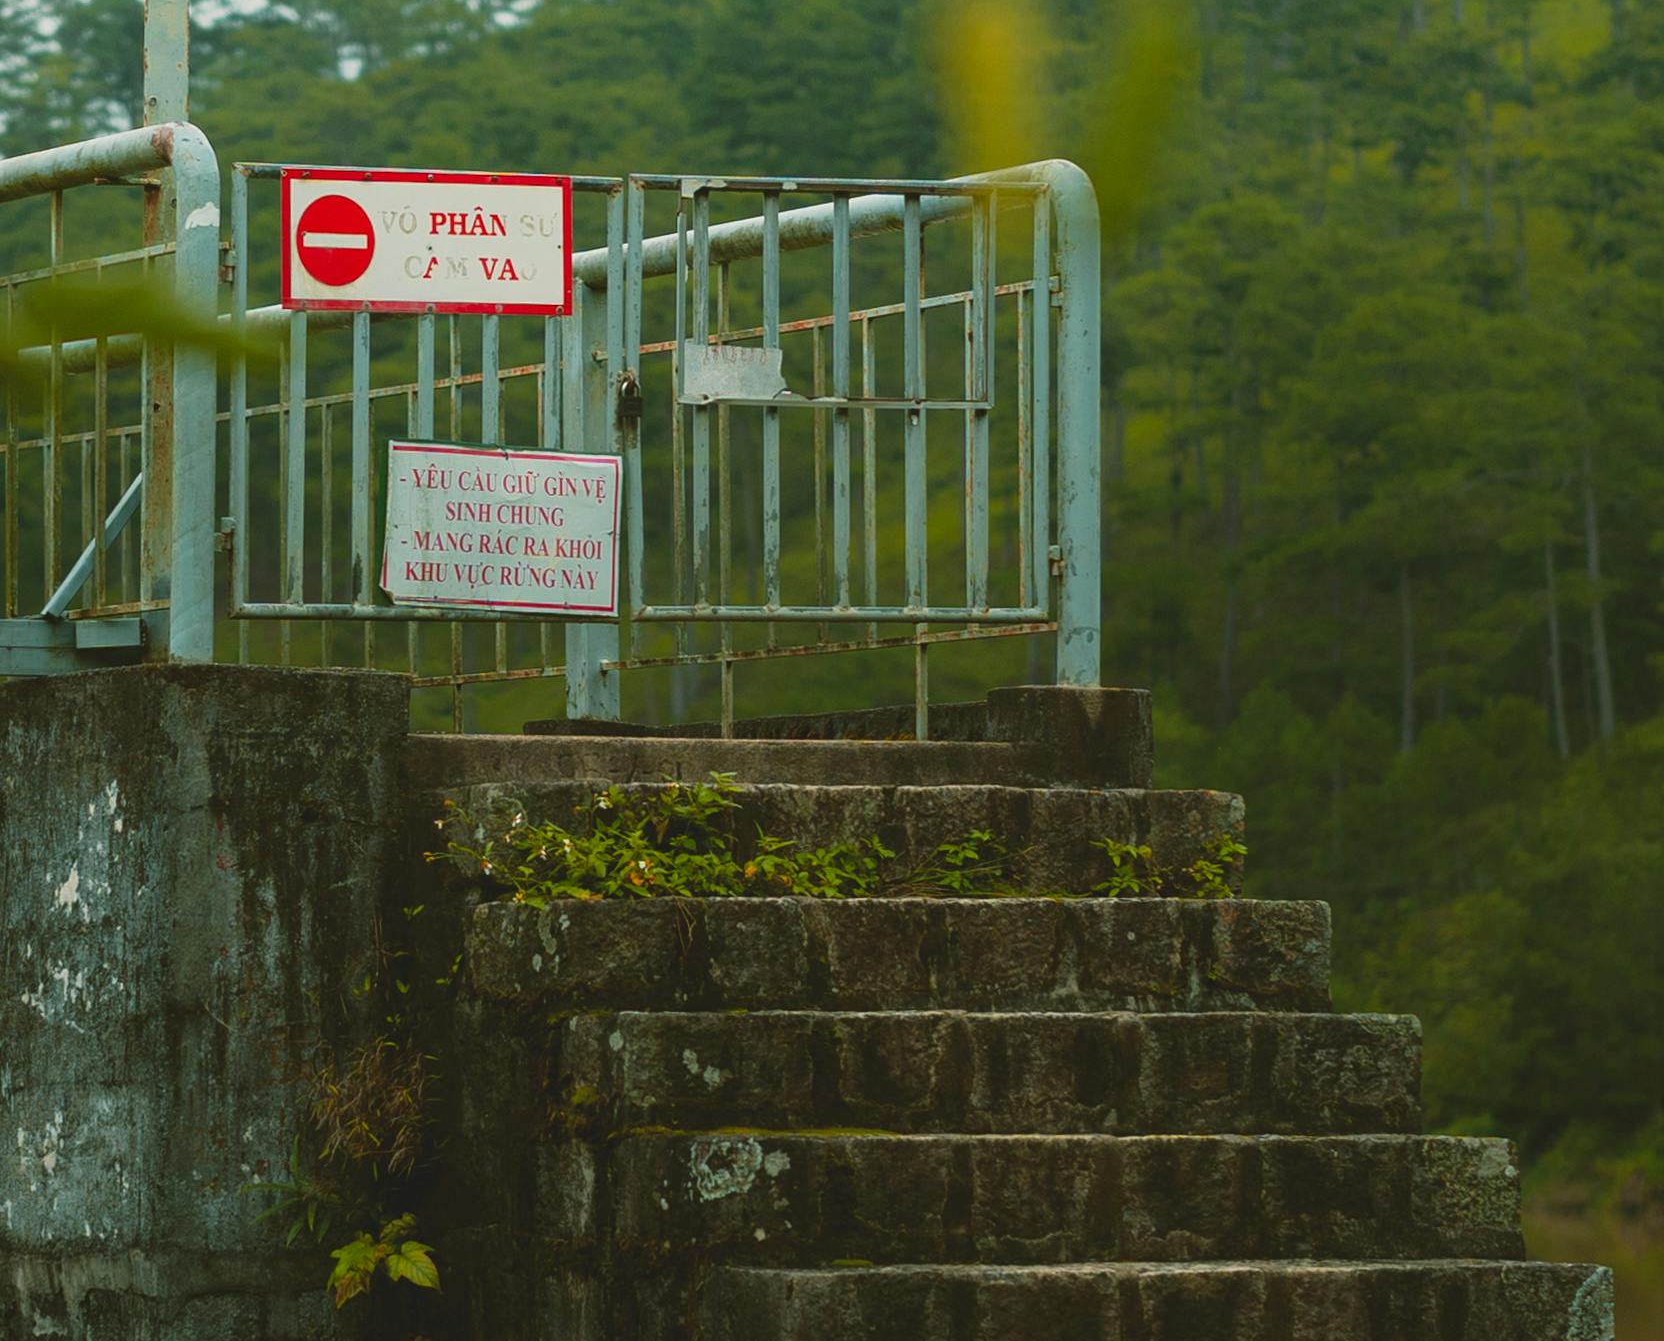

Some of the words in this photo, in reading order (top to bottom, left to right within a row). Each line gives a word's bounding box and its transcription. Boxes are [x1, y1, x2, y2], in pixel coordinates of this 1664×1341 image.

[412, 463, 453, 490] YÊU
[503, 470, 540, 495] GIỮ
[544, 471, 577, 497] GÌN
[581, 475, 606, 504] VỆ
[445, 501, 492, 523] SINH
[496, 504, 564, 527] CHUNG
[413, 530, 474, 553] MANG
[478, 529, 519, 556] RÁC
[523, 536, 549, 557] RA
[405, 561, 448, 583] KHU
[453, 562, 495, 589] VỰC
[500, 561, 556, 589] RỪNG
[561, 564, 599, 591] NÀY
